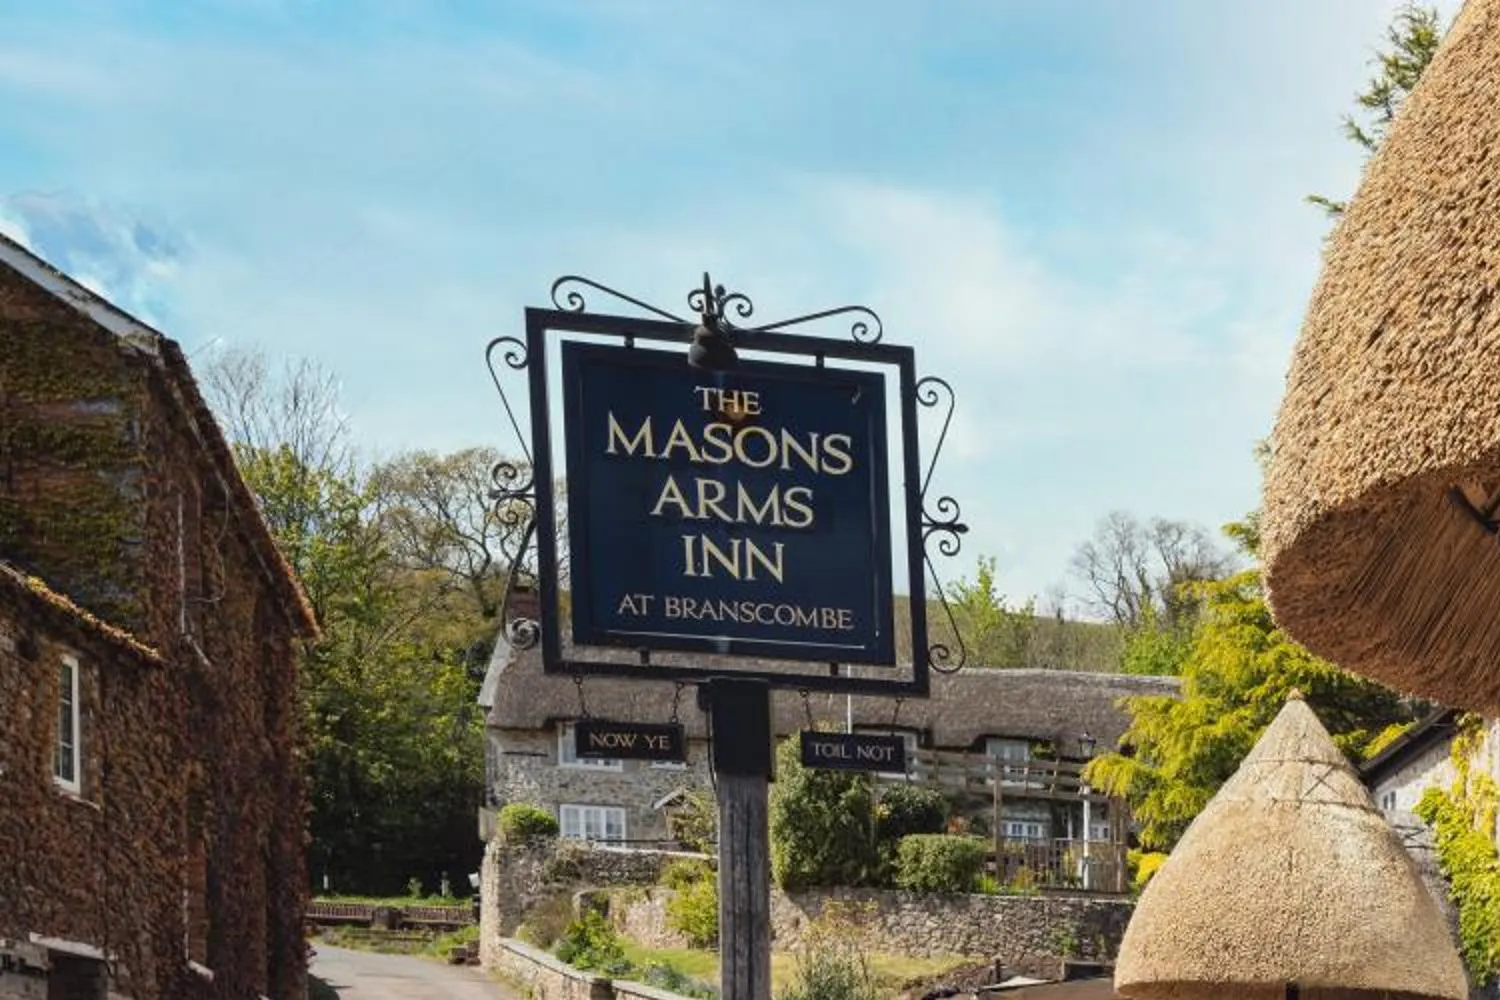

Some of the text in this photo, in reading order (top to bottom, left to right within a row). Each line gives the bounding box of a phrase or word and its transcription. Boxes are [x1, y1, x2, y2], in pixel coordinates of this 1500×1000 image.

[695, 385, 761, 415] THE
[606, 411, 853, 475] MASONS
[650, 476, 815, 528] ARMS
[682, 535, 784, 584] INN
[618, 594, 855, 631] AT BRANSCOMBE
[589, 733, 671, 750] NOW YE
[813, 743, 895, 761] TOIL NOT
